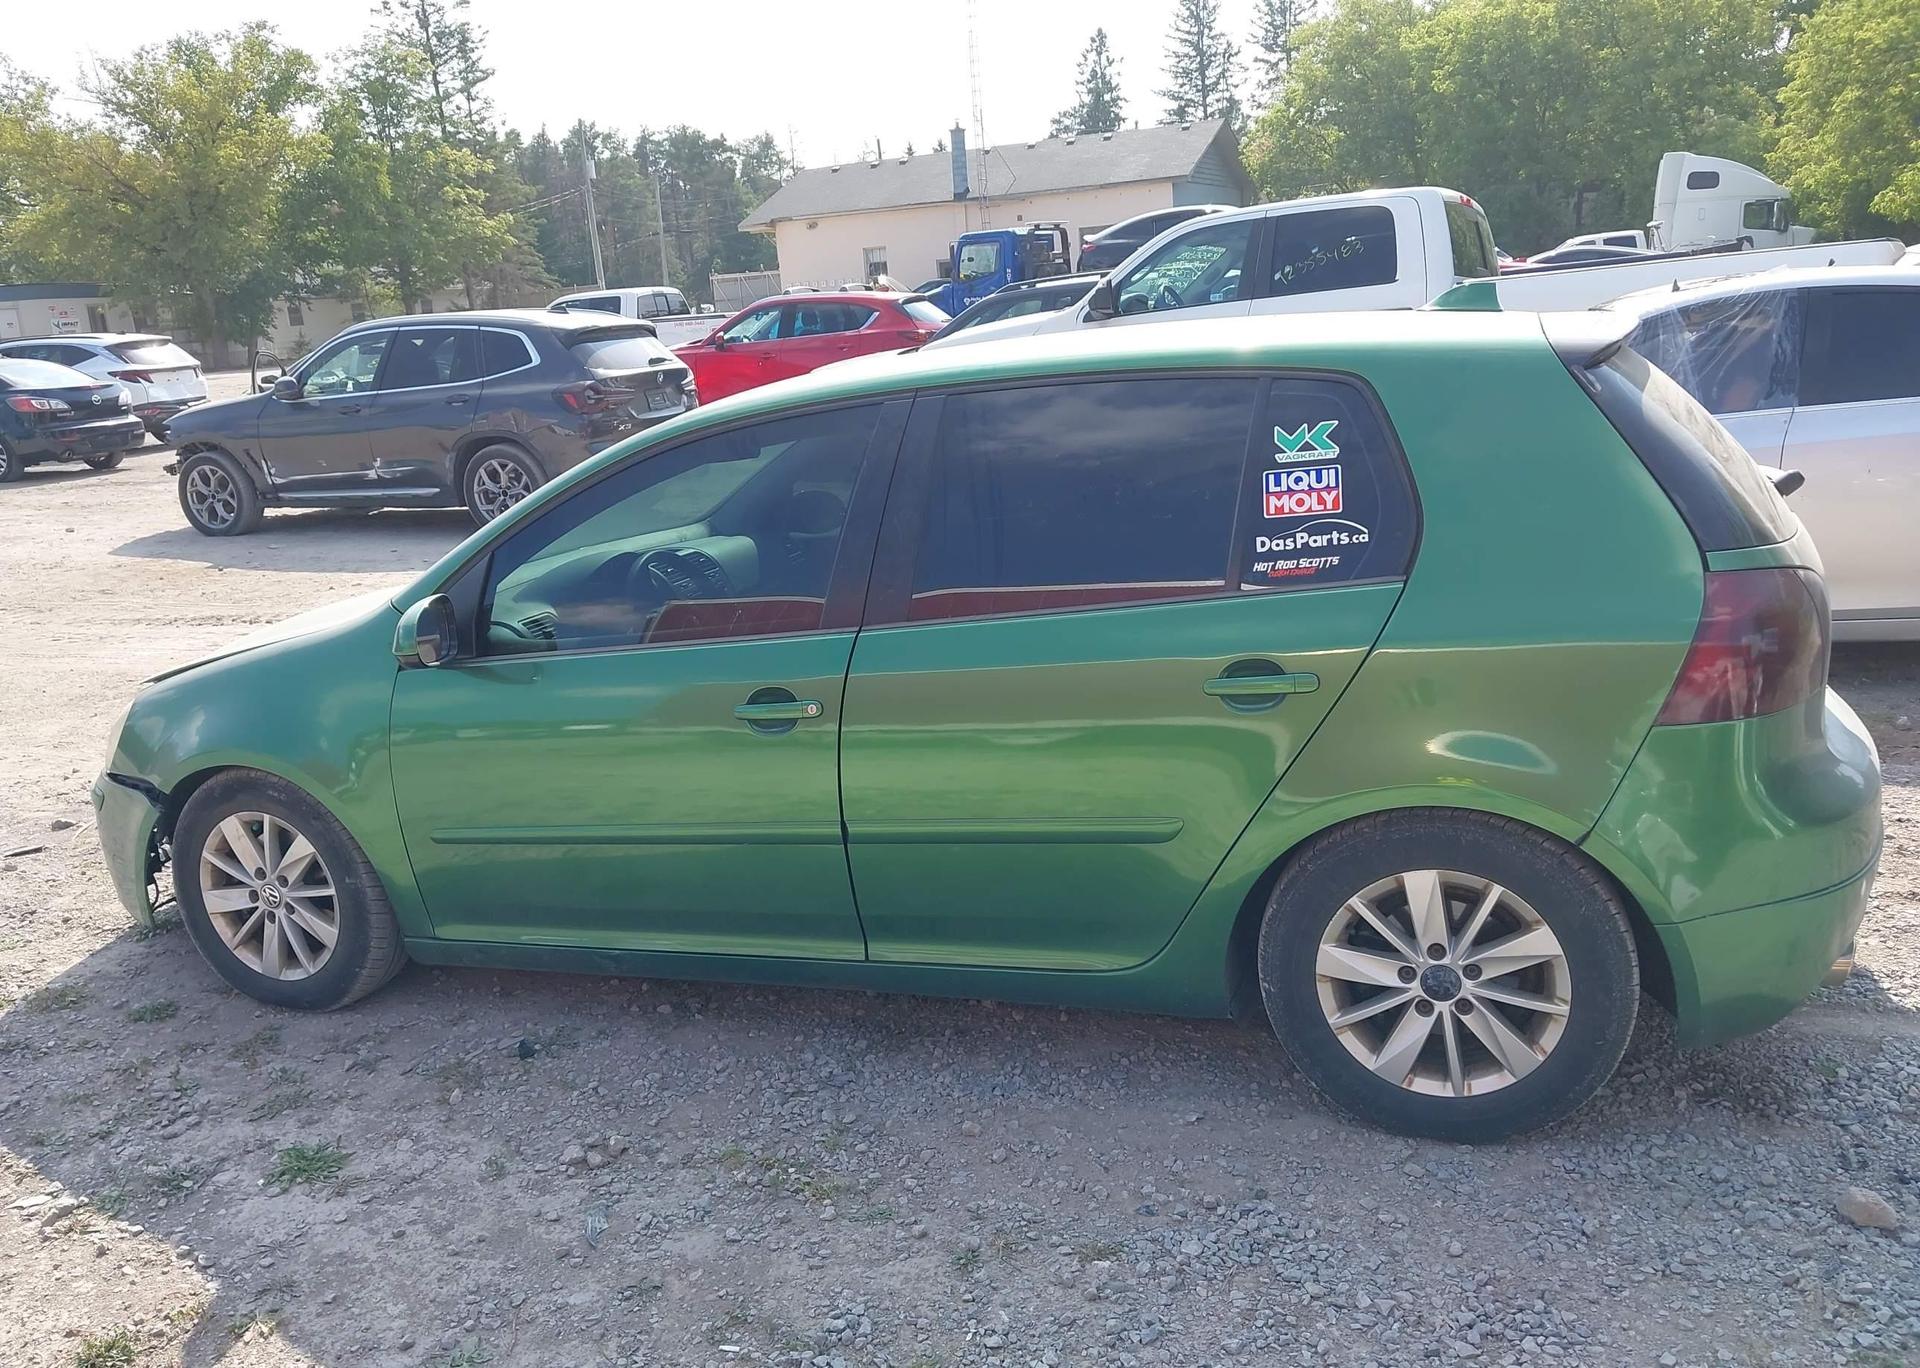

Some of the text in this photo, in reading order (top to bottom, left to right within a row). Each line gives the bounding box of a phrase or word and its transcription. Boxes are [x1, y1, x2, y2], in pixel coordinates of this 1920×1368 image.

[1277, 450, 1338, 461] VAGKRAFT
[1268, 468, 1338, 493] LIQUI
[1269, 490, 1339, 515] MOLY
[1255, 530, 1369, 553] DasParts.ca
[1252, 556, 1341, 574] HOT ROD SCOTTS
